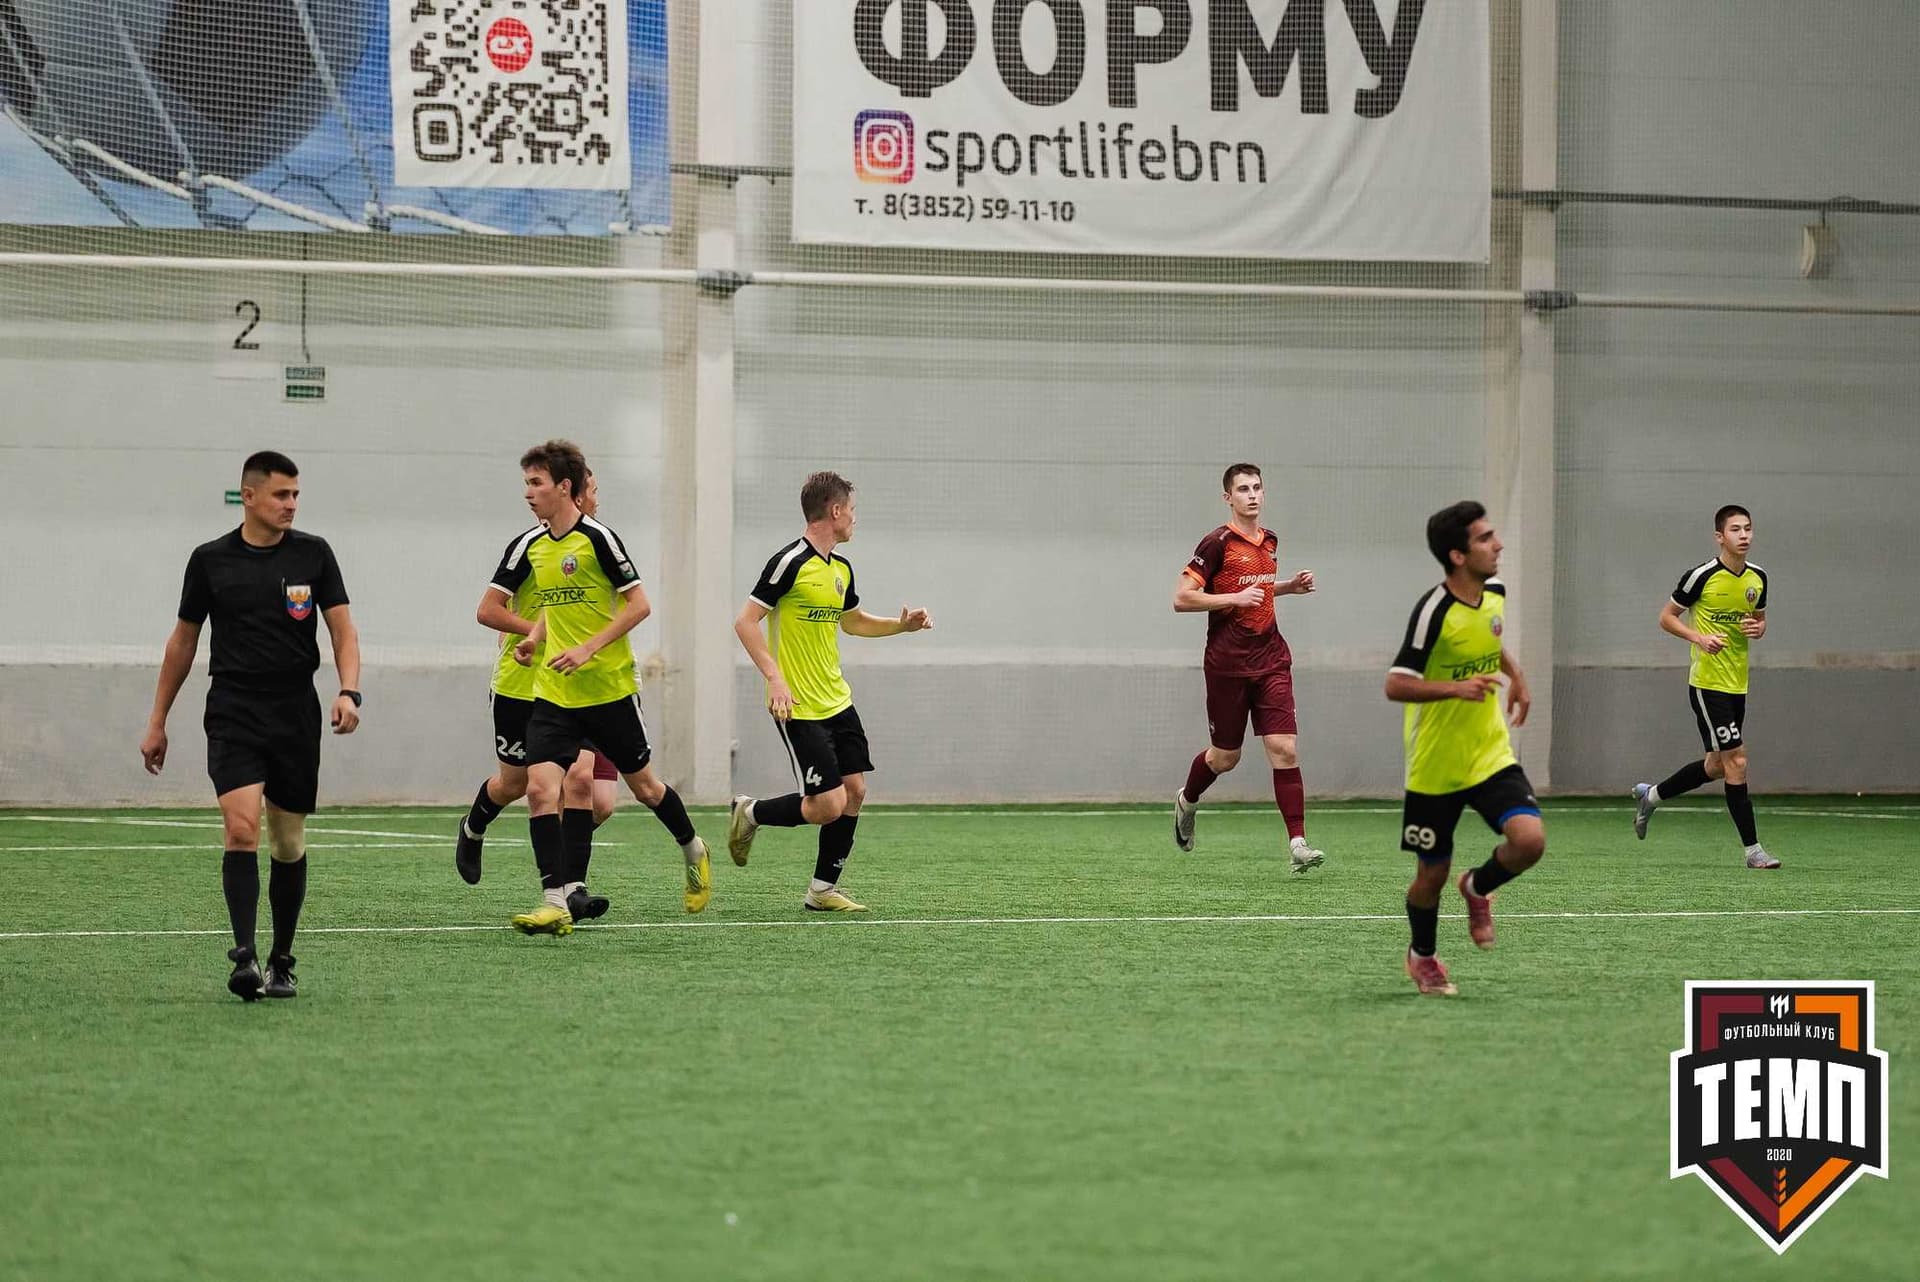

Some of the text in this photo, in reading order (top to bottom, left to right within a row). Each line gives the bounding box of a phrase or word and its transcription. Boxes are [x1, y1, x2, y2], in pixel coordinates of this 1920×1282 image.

[854, 0, 1425, 118] ФОРМУ
[924, 121, 1268, 187] sportlifebrn
[883, 192, 975, 222] 8(3852)
[981, 197, 1076, 222] 59-11-10
[233, 300, 260, 350] 2
[1716, 721, 1741, 744] 95
[496, 735, 527, 760] 24
[805, 765, 823, 787] 4
[1404, 823, 1437, 851] 69
